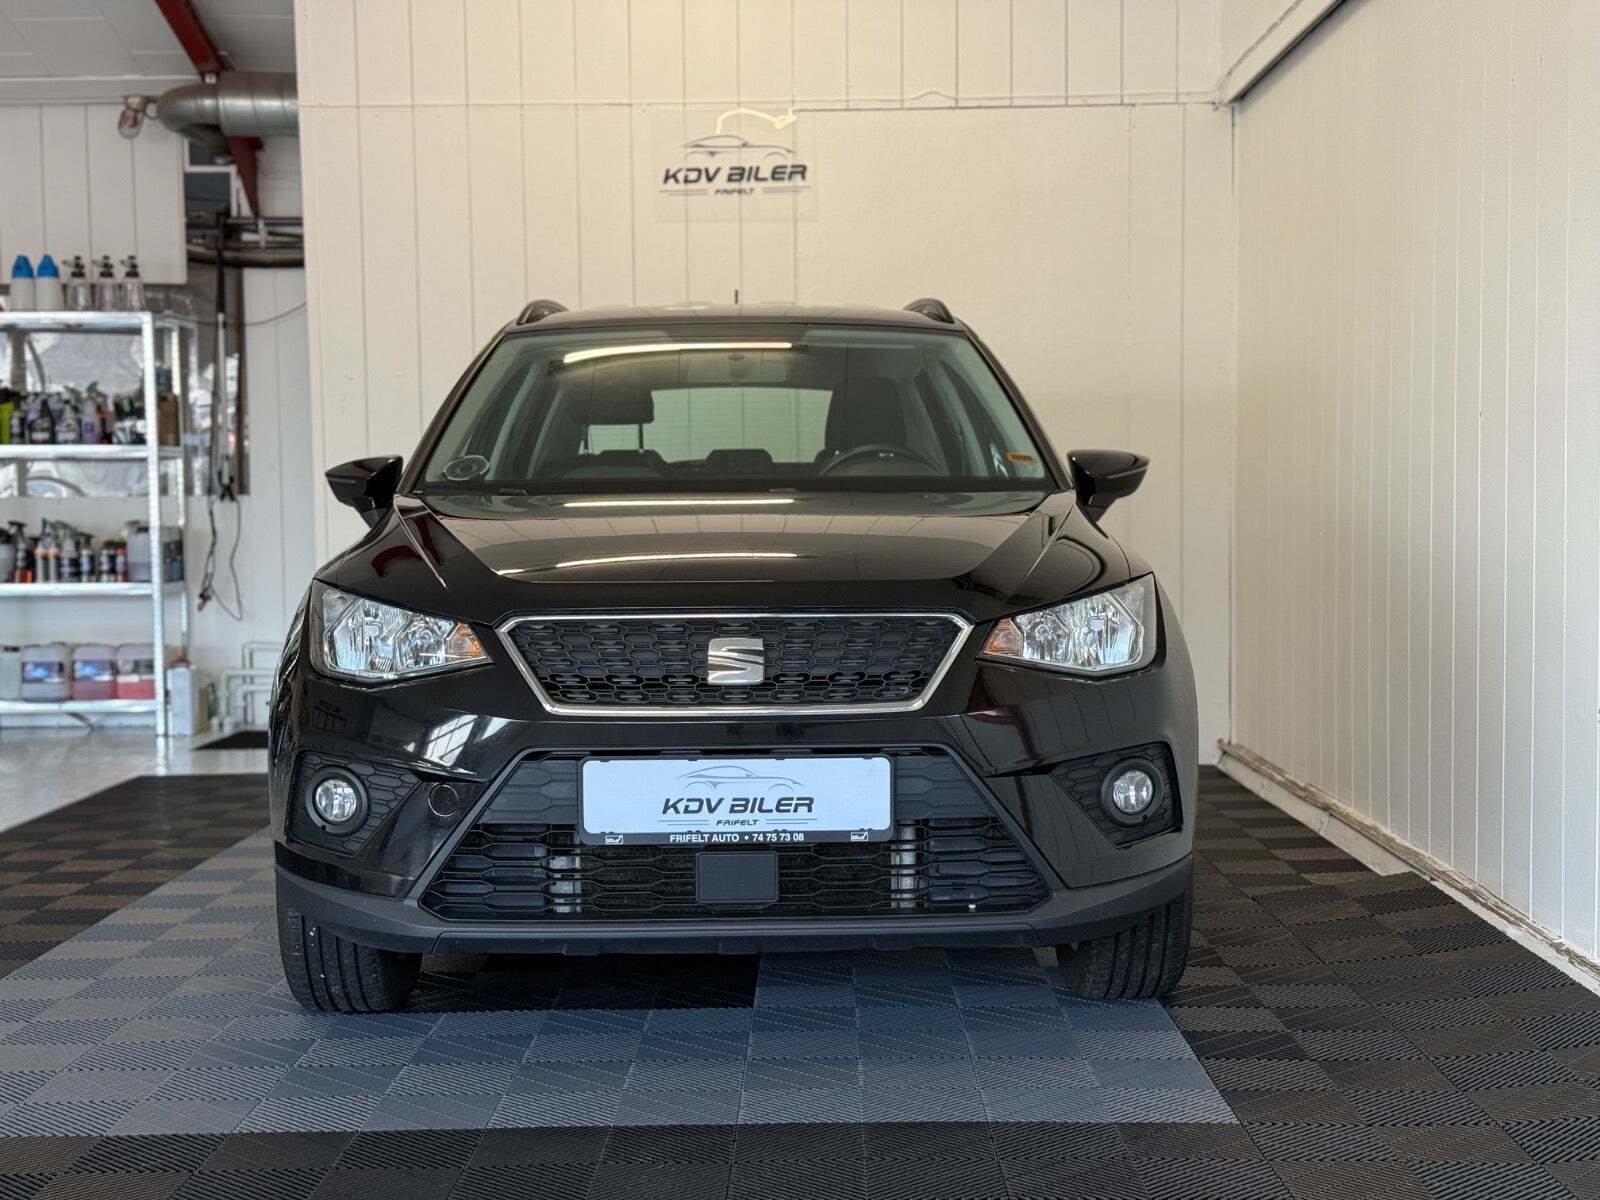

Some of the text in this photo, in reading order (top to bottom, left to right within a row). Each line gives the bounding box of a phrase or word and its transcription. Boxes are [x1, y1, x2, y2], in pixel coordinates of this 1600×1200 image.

[663, 164, 808, 184] KDV BILER
[662, 797, 814, 814] KDV BILER
[669, 832, 805, 843] FRIFELT AUTO 74 75 73 08
